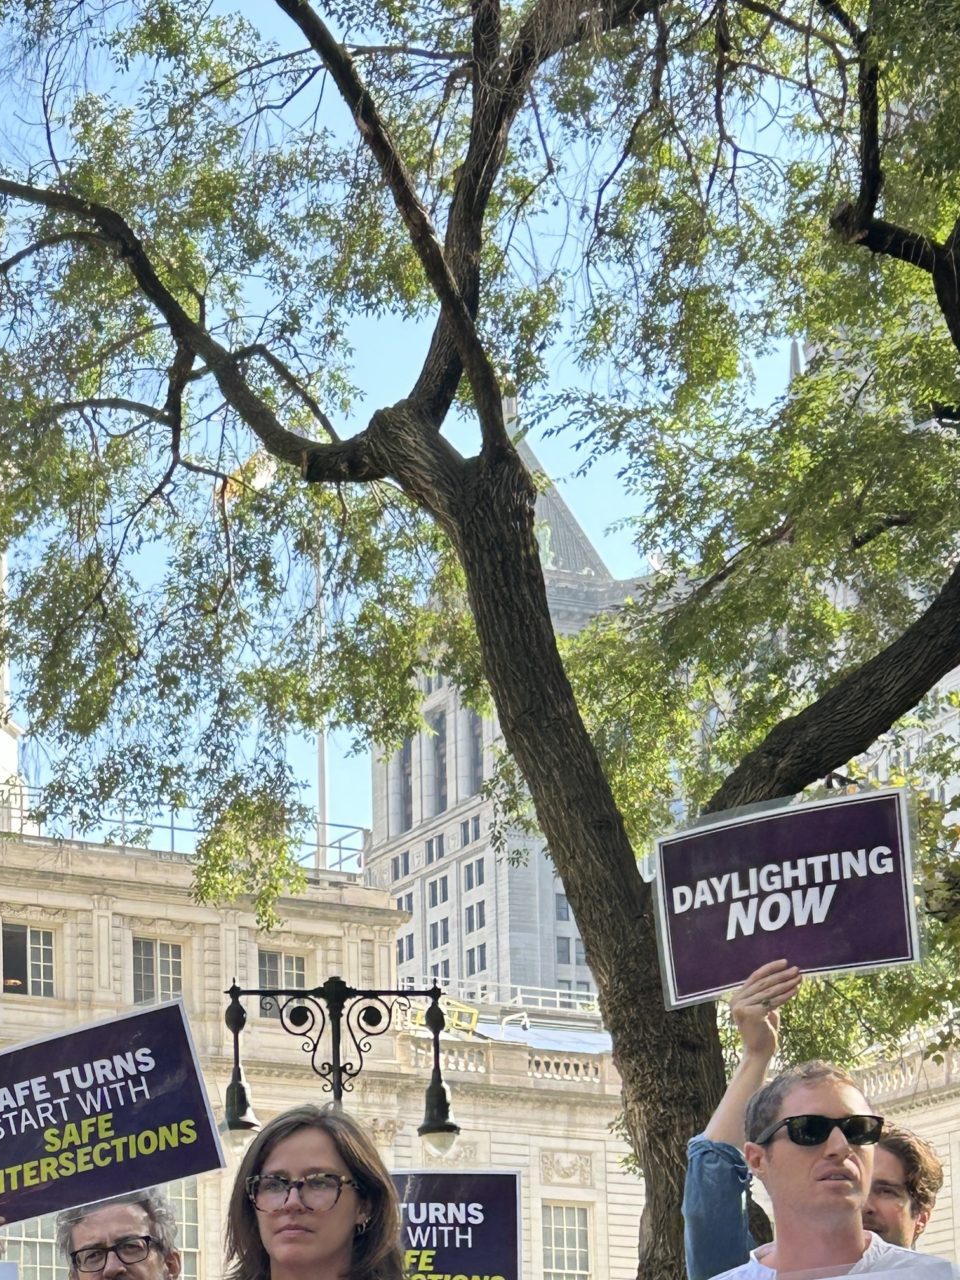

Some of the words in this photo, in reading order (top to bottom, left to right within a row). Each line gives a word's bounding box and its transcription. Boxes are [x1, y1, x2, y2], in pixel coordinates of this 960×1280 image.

[672, 845, 894, 915] DAYLIGHTING
[726, 885, 837, 941] NOW
[53, 1047, 156, 1095] TURNS
[75, 1076, 150, 1116] WITH
[43, 1112, 115, 1153] SAFE
[407, 1226, 472, 1248] WITH
